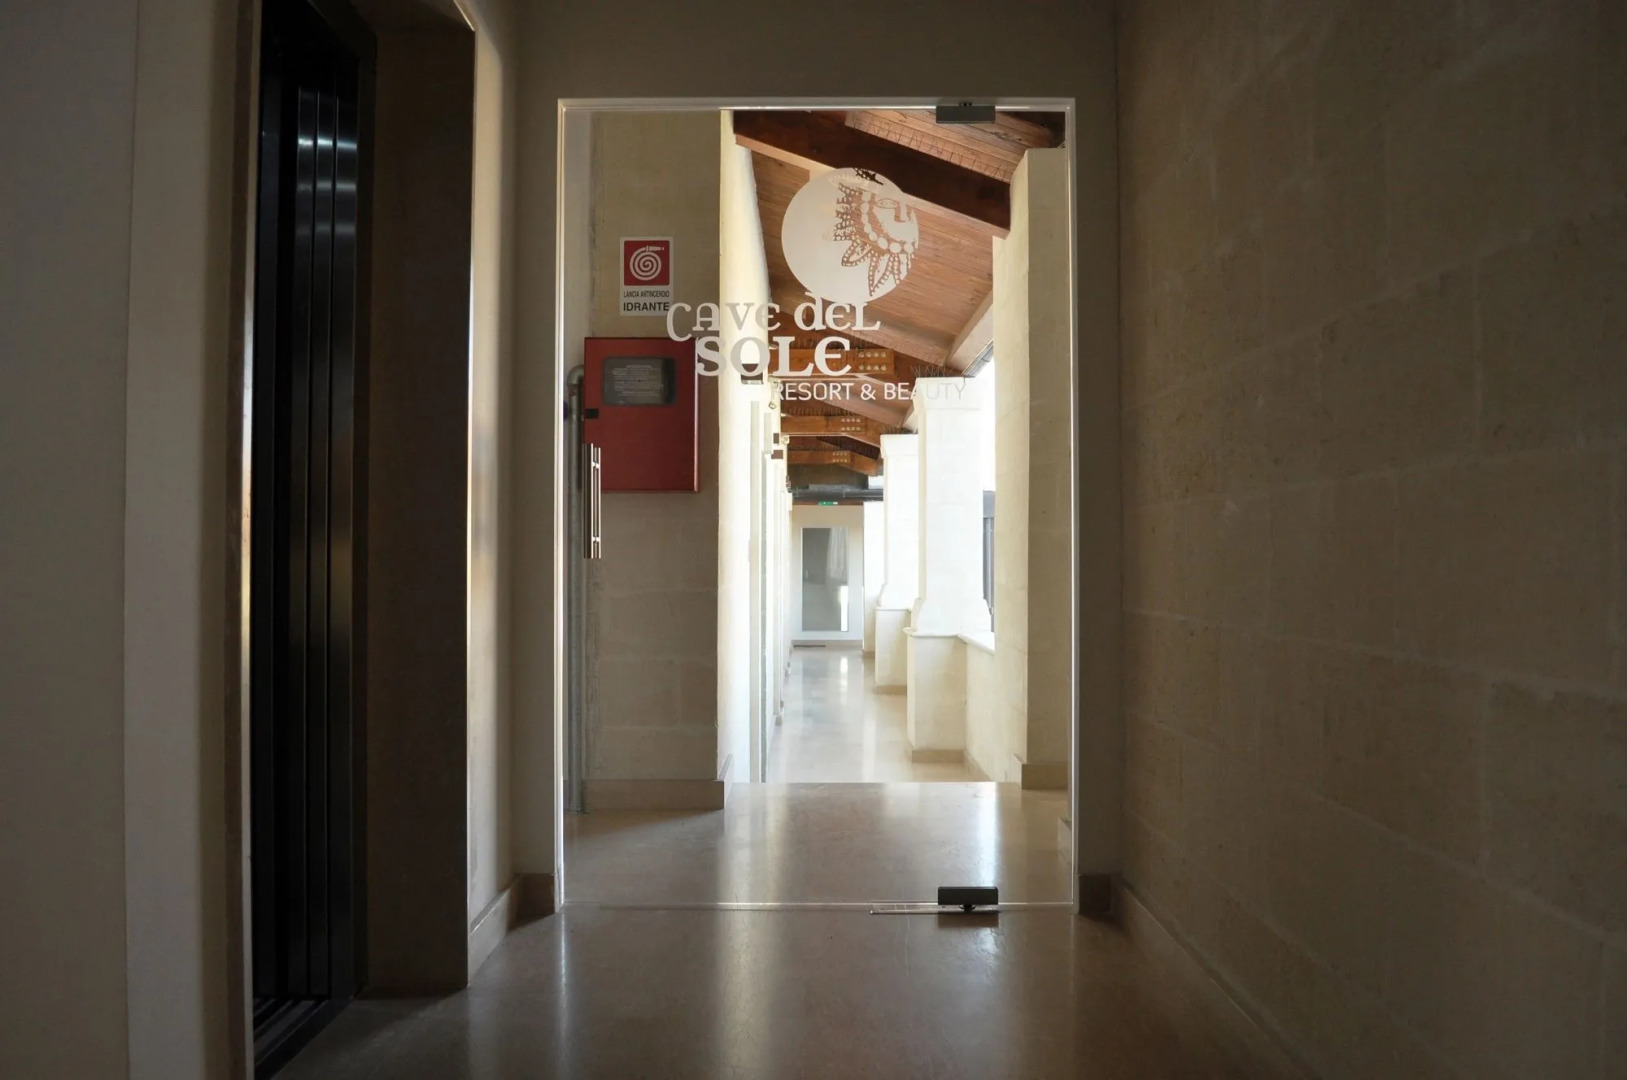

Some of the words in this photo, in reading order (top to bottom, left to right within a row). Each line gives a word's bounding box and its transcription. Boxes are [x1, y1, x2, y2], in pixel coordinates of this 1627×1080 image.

[623, 302, 670, 312] IDRANTE
[696, 336, 852, 377] SOLE
[774, 382, 854, 400] RESORT
[860, 383, 876, 400] &
